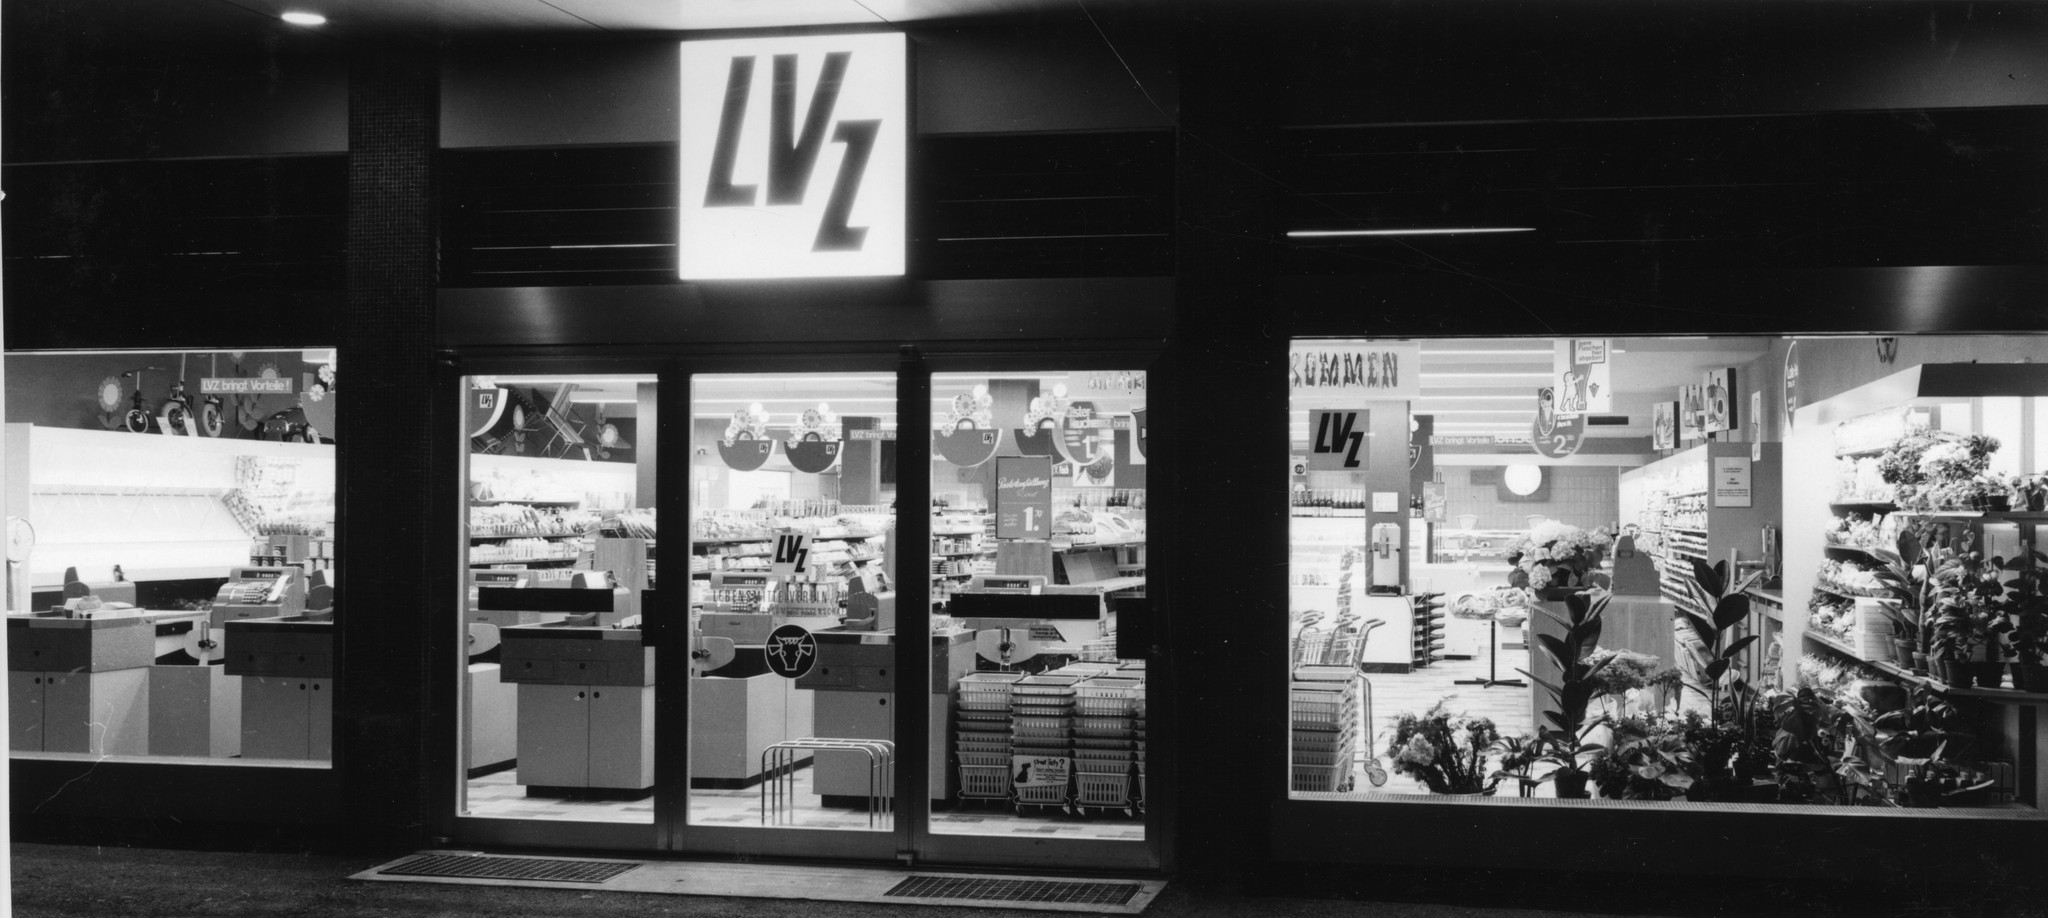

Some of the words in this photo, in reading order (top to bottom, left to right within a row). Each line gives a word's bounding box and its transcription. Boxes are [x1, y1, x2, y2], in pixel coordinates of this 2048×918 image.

[703, 51, 883, 252] LVZ
[203, 380, 219, 391] LVZ
[221, 380, 248, 392] bringt
[1313, 412, 1365, 468] LVZ
[775, 535, 808, 573] LVZ
